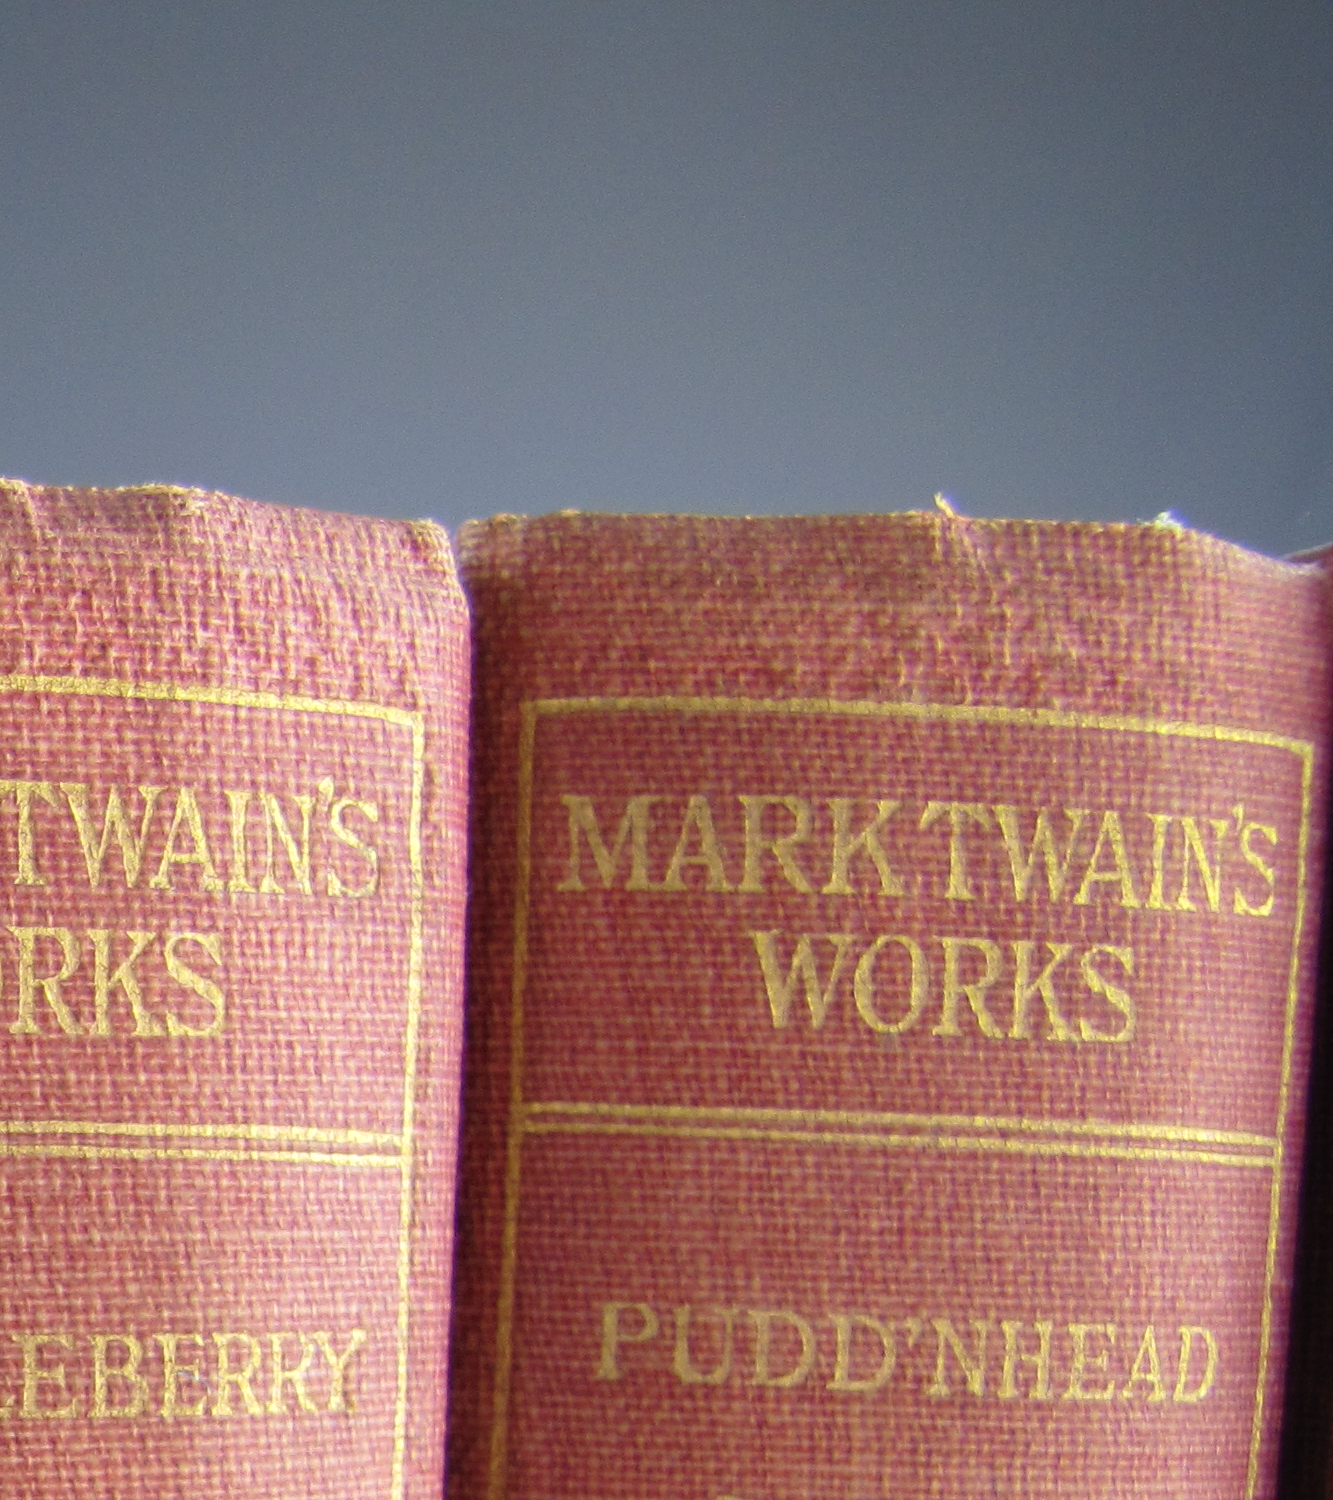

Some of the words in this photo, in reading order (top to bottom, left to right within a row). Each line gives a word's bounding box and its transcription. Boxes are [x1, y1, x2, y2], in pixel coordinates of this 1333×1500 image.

[557, 794, 906, 897] MARK
[918, 800, 1278, 917] TWAIN'S
[751, 929, 1134, 1043] WORKS
[597, 1301, 1220, 1403] PUDD'NHEAD
